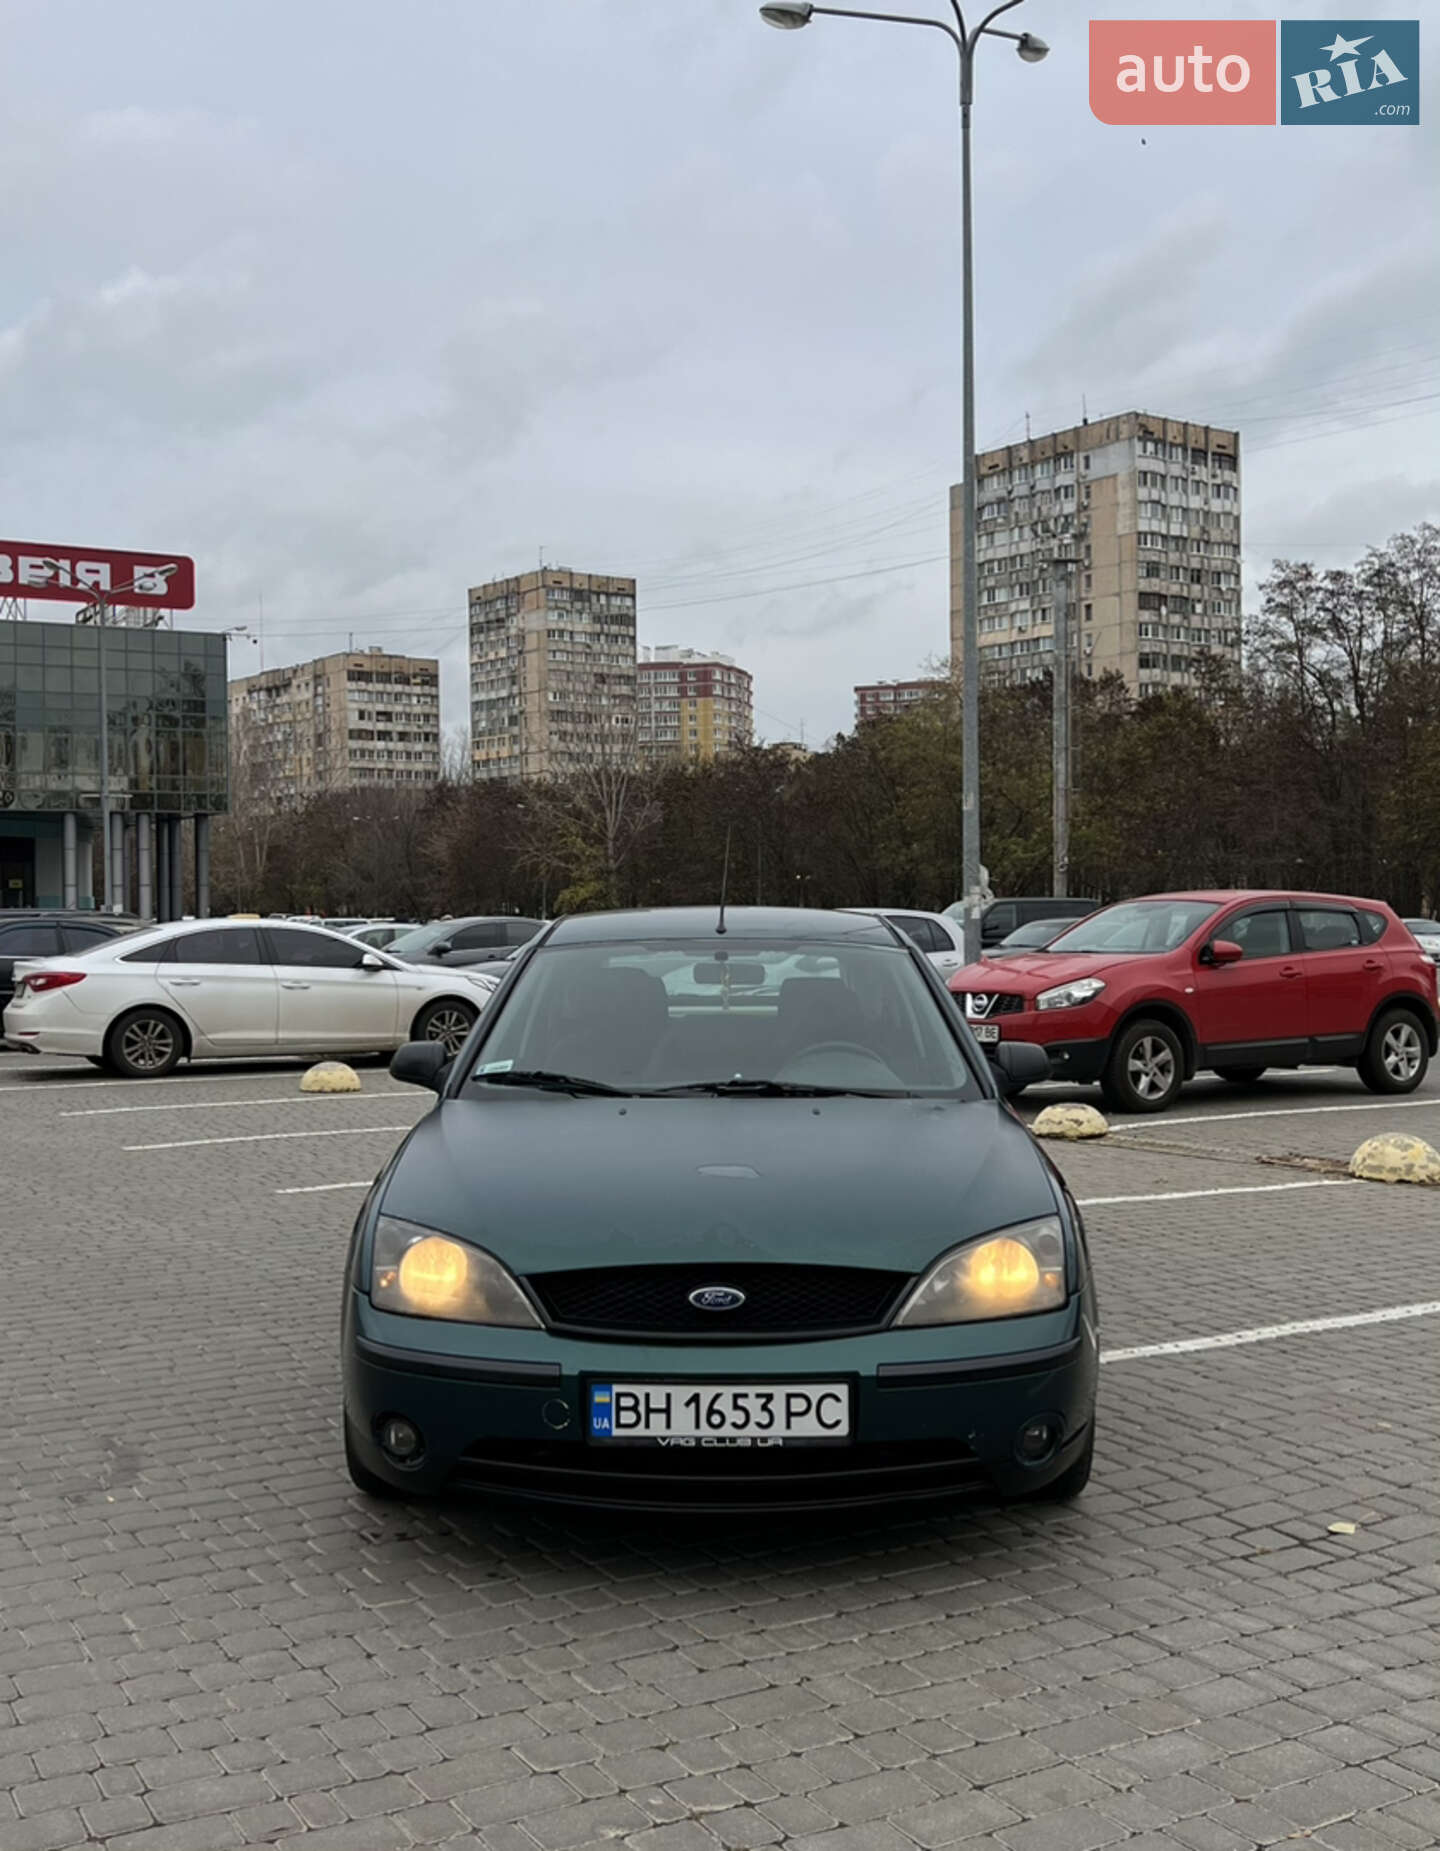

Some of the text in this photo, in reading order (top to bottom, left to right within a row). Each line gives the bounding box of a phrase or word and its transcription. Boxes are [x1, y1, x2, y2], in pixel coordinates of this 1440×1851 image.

[614, 1392, 843, 1430] BH 1653 PC
[593, 1418, 610, 1430] UA
[656, 1437, 696, 1447] VAG
[701, 1437, 752, 1447] CLUB
